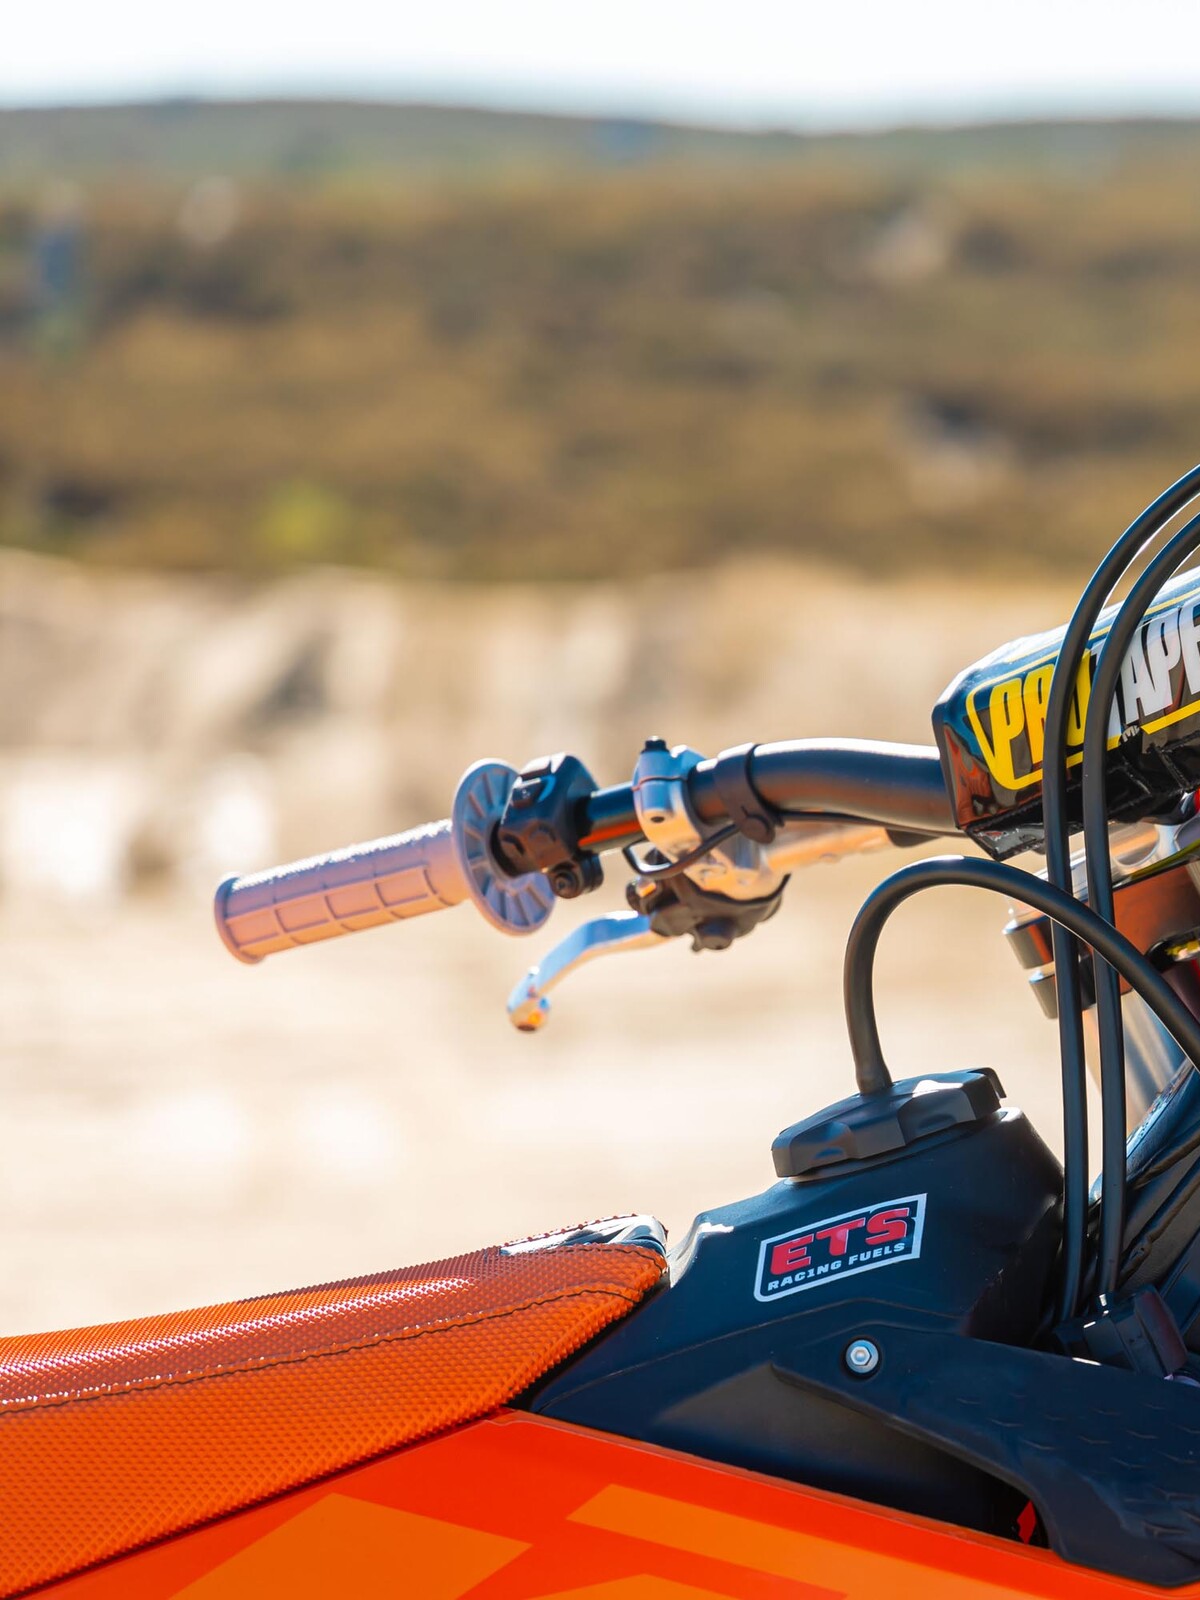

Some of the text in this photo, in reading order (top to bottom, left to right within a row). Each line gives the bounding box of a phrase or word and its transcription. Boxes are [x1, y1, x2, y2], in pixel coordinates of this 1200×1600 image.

[767, 1242, 906, 1291] RACING FUELS
[770, 1207, 910, 1275] ETS
